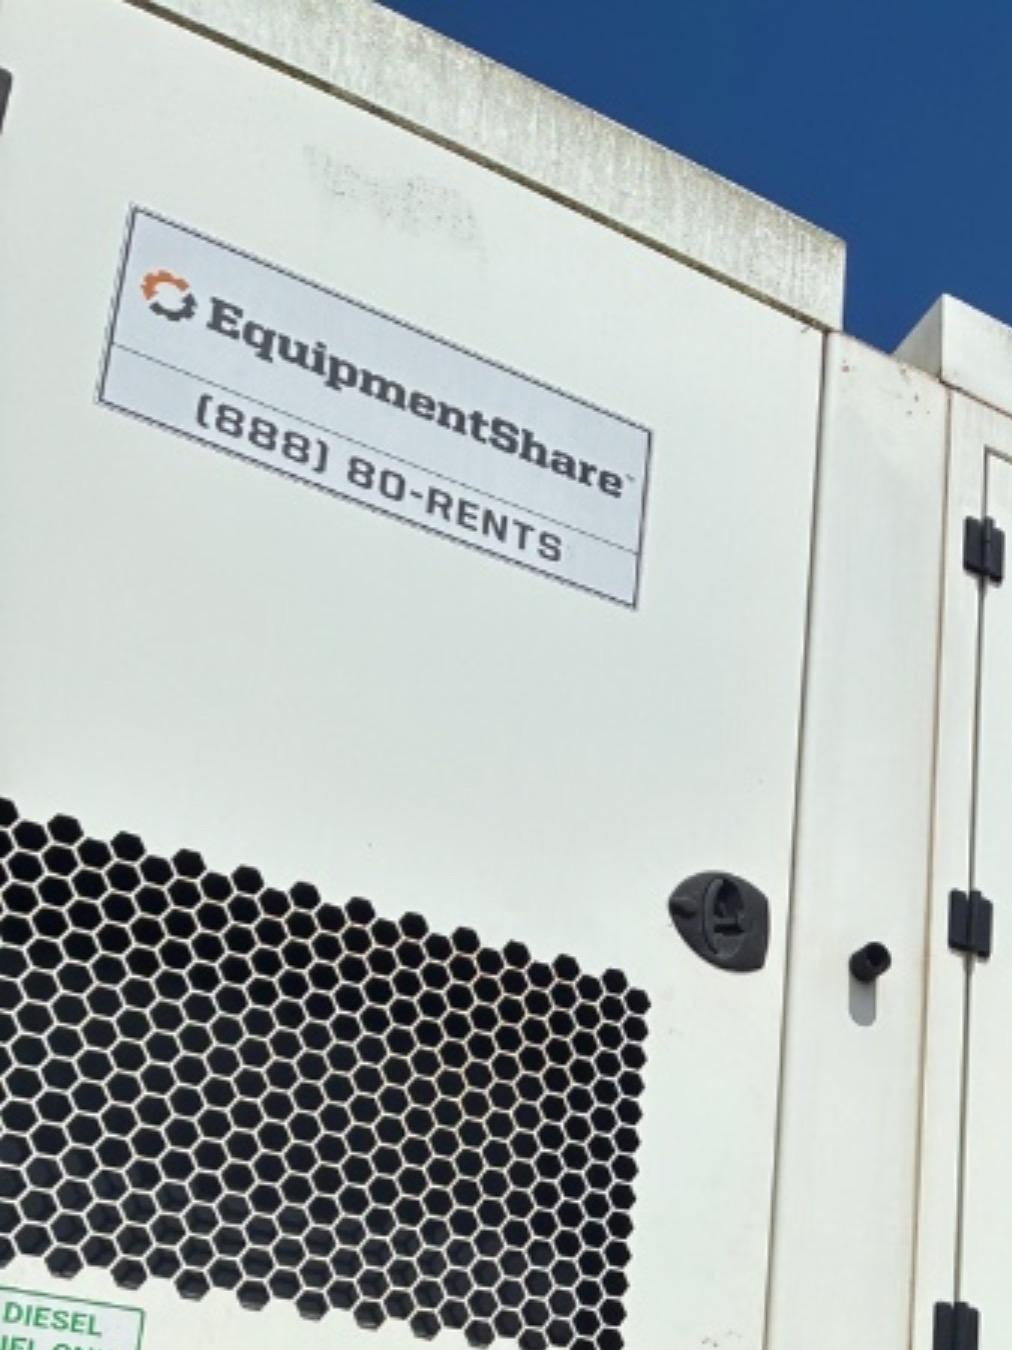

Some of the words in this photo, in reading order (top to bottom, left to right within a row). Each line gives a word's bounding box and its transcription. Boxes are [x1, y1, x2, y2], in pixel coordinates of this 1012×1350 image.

[195, 393, 329, 475] (888)
[347, 460, 564, 565] 80-RENTS
[206, 297, 626, 500] EquipmentShare
[3, 1301, 101, 1336] DIESEL
